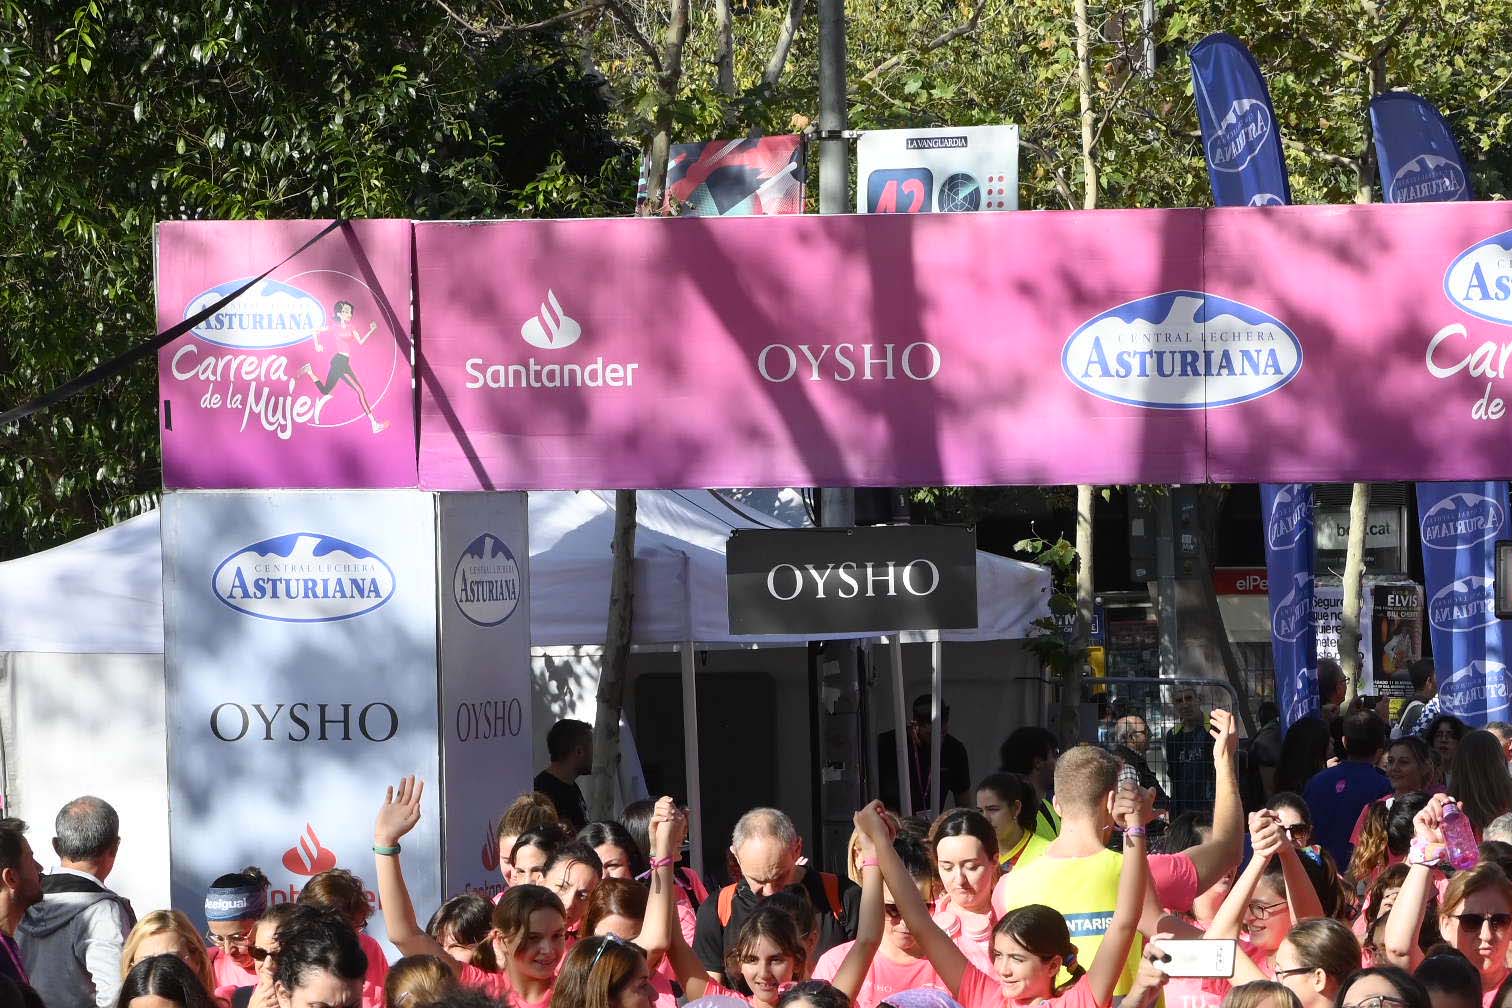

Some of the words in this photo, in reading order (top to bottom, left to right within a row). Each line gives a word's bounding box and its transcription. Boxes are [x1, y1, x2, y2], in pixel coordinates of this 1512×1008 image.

[908, 140, 917, 148] LA
[917, 137, 967, 148] VANGUARDIA
[195, 303, 314, 331] ASTURIANA
[1118, 332, 1192, 343] CENTRAL
[1200, 330, 1276, 343] LECHERA
[171, 343, 288, 382] Carrera
[465, 356, 639, 389] Santander
[757, 341, 941, 383] OYSHO
[1081, 335, 1284, 378] ASTURIANA
[200, 384, 222, 409] de
[227, 381, 243, 409] la
[240, 378, 333, 440] Mujer
[1472, 382, 1506, 421] de
[1337, 522, 1391, 538] b.cat
[227, 566, 382, 600] ASTURIANA
[254, 564, 310, 573] CENTRAL
[318, 563, 375, 573] LECHERA
[766, 559, 940, 601] OYSHO
[1236, 575, 1268, 591] elPe
[459, 568, 517, 603] ASTURIANA
[1387, 594, 1417, 606] ELVIS
[210, 702, 399, 742] OYSHO
[456, 698, 522, 742] OYSHO
[1066, 917, 1113, 931] NTARIS
